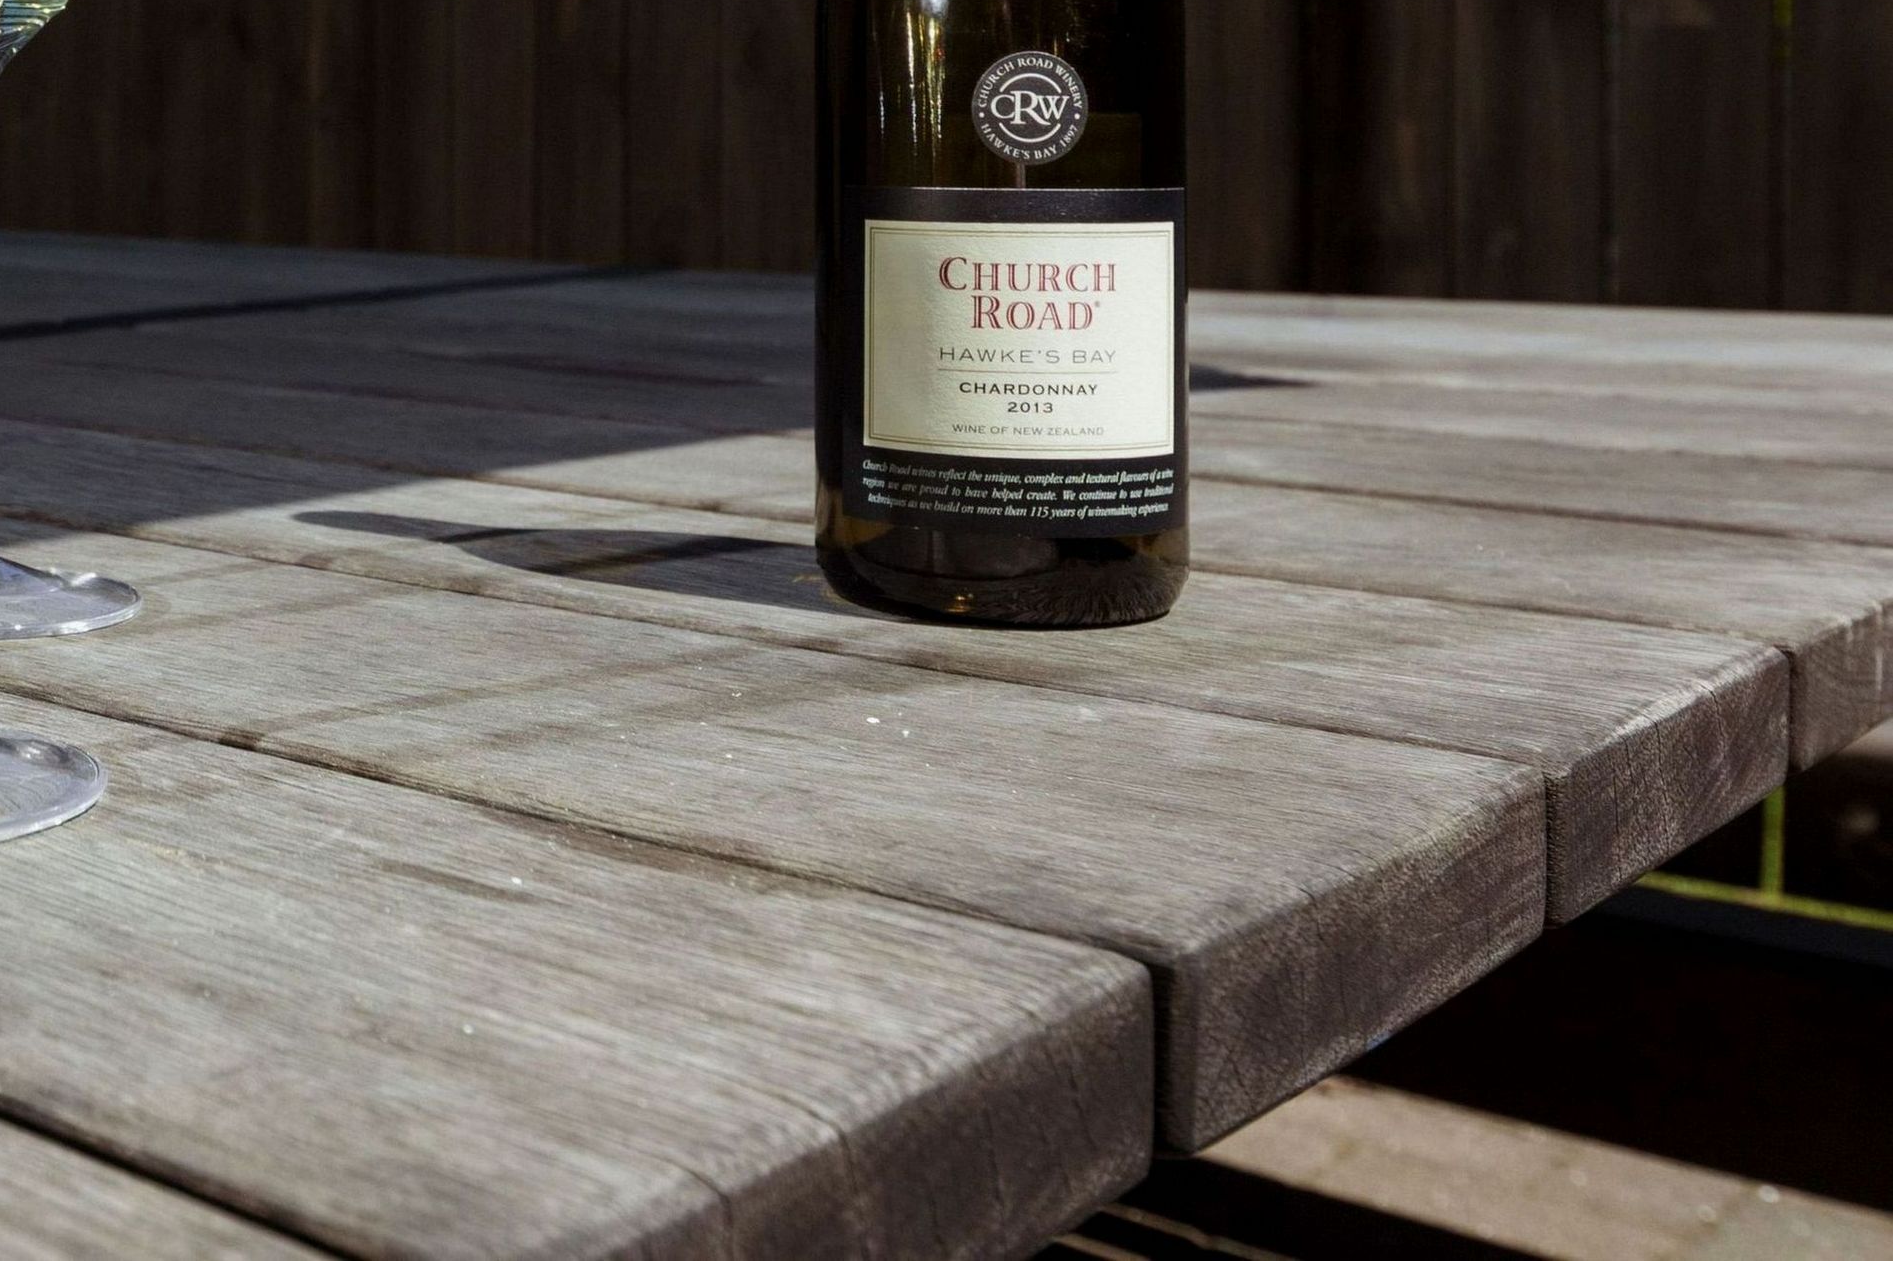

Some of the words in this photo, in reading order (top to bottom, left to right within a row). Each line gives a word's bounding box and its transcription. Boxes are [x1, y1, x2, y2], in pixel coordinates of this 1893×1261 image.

[978, 62, 1015, 108] CHURCH
[1017, 57, 1054, 70] ROAD
[1055, 65, 1083, 109] WINERY
[990, 90, 1070, 126] CRW
[980, 123, 1031, 160] HAWKE'S
[1034, 145, 1057, 160] BAY
[1059, 124, 1079, 148] 1897
[939, 256, 1117, 293] CHURCH
[971, 295, 1094, 330] ROAD
[939, 346, 1061, 364] HAWKE'S
[1072, 349, 1117, 364] BAY
[959, 381, 1098, 395] CHARDONNAY
[1007, 402, 1054, 413] 2013
[952, 424, 986, 434] WINE
[990, 425, 1009, 434] OF
[1013, 425, 1043, 435] NEW
[1047, 426, 1105, 436] ZEALAND
[938, 468, 966, 481] reflect
[967, 469, 983, 481] the
[984, 472, 1022, 486] unique,
[1024, 472, 1064, 486] complex
[1065, 472, 1086, 483] and
[919, 484, 949, 495] proud
[951, 486, 961, 497] to
[965, 486, 988, 498] have
[991, 488, 1024, 502] helped
[1026, 490, 1057, 501] create.
[1062, 490, 1076, 500] We
[1079, 489, 1118, 500] continue
[933, 500, 961, 513] build
[961, 505, 974, 514] on
[976, 506, 1004, 516] more
[1004, 504, 1027, 516] than
[1030, 506, 1050, 518] 115
[1049, 508, 1076, 520] years
[1076, 505, 1089, 520] of
[1087, 505, 1138, 517] winemaking
